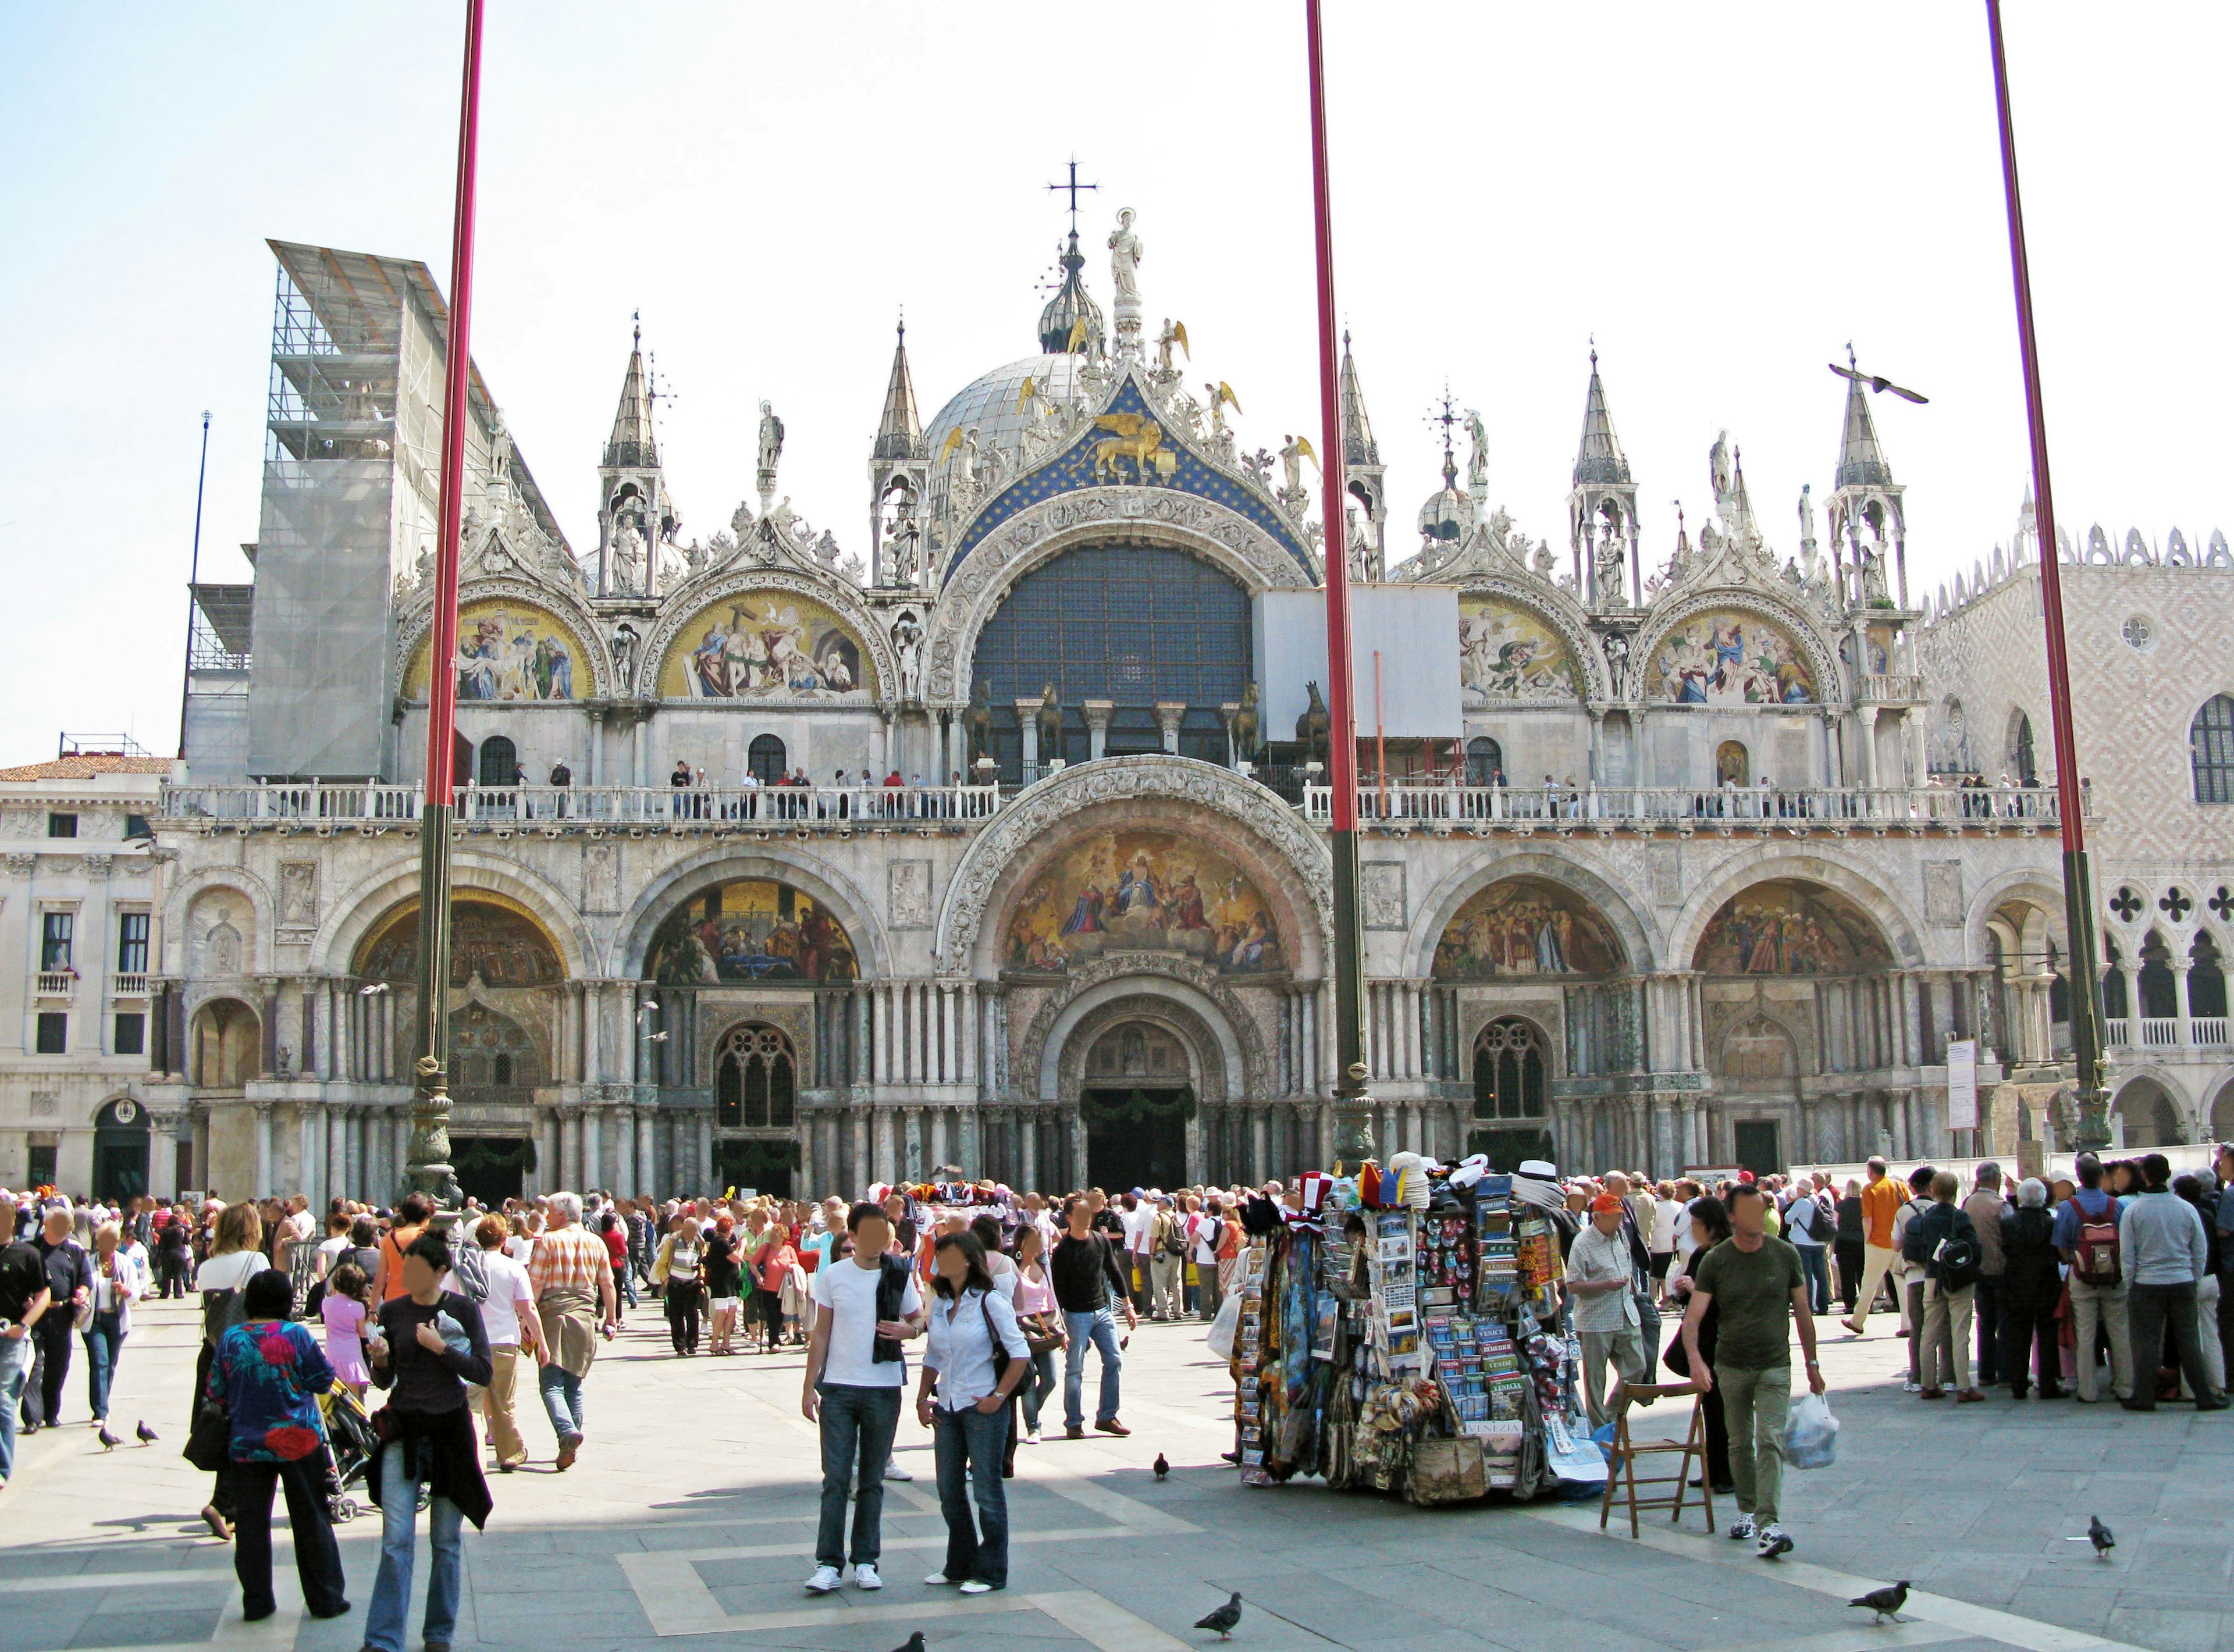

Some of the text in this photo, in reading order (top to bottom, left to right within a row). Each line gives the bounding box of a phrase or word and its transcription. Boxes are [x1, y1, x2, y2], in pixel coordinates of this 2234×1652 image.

[1479, 1329, 1504, 1337] VENICE
[1489, 1360, 1512, 1368] VENISE
[1493, 1382, 1521, 1391] VENECIA
